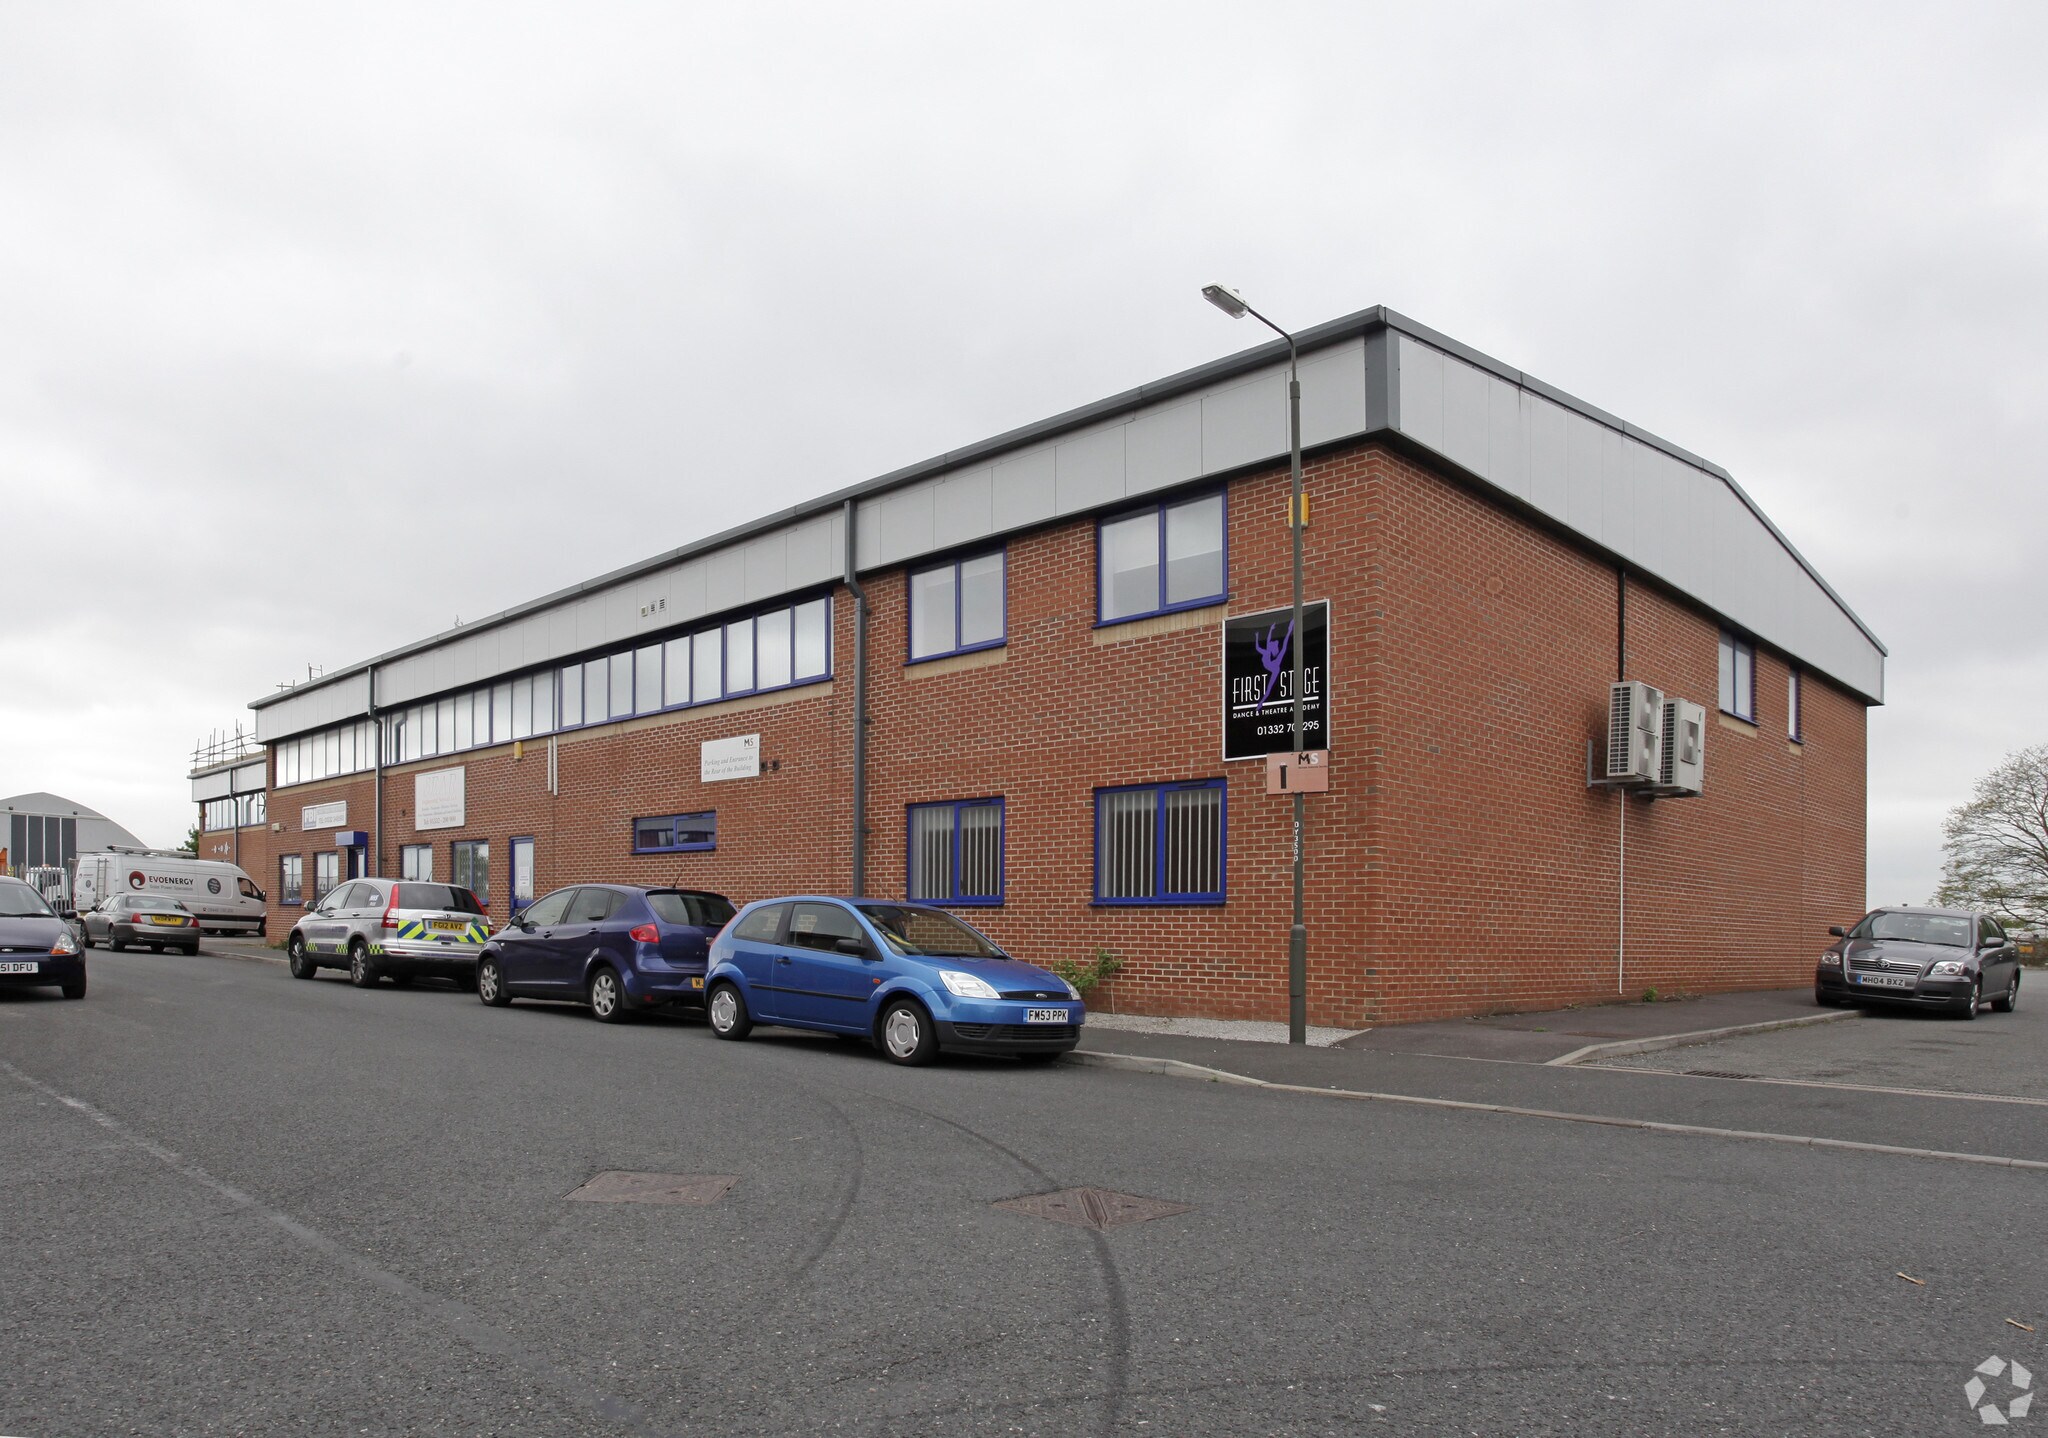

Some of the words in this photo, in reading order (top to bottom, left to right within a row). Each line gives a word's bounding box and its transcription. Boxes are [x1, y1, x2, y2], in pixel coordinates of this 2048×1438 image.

[1233, 674, 1267, 703] FIRST
[1280, 666, 1319, 698] STGE
[1233, 711, 1253, 719] DANCE
[1262, 707, 1287, 716] THEATRE
[1289, 703, 1320, 712] ADEMY
[1257, 724, 1284, 736] 01332
[1287, 720, 1320, 733] 70295
[744, 738, 754, 747] MS
[704, 758, 721, 767] Parking
[729, 755, 748, 763] Entrance
[1298, 753, 1319, 765] MS
[148, 875, 194, 885] EVOENERGY
[450, 922, 463, 930] AVZ
[13, 963, 33, 972] DFU
[1862, 976, 1884, 985] MH04
[1886, 978, 1904, 986] BXZ
[1028, 1010, 1051, 1020] FM53
[1052, 1010, 1067, 1020] PPK
